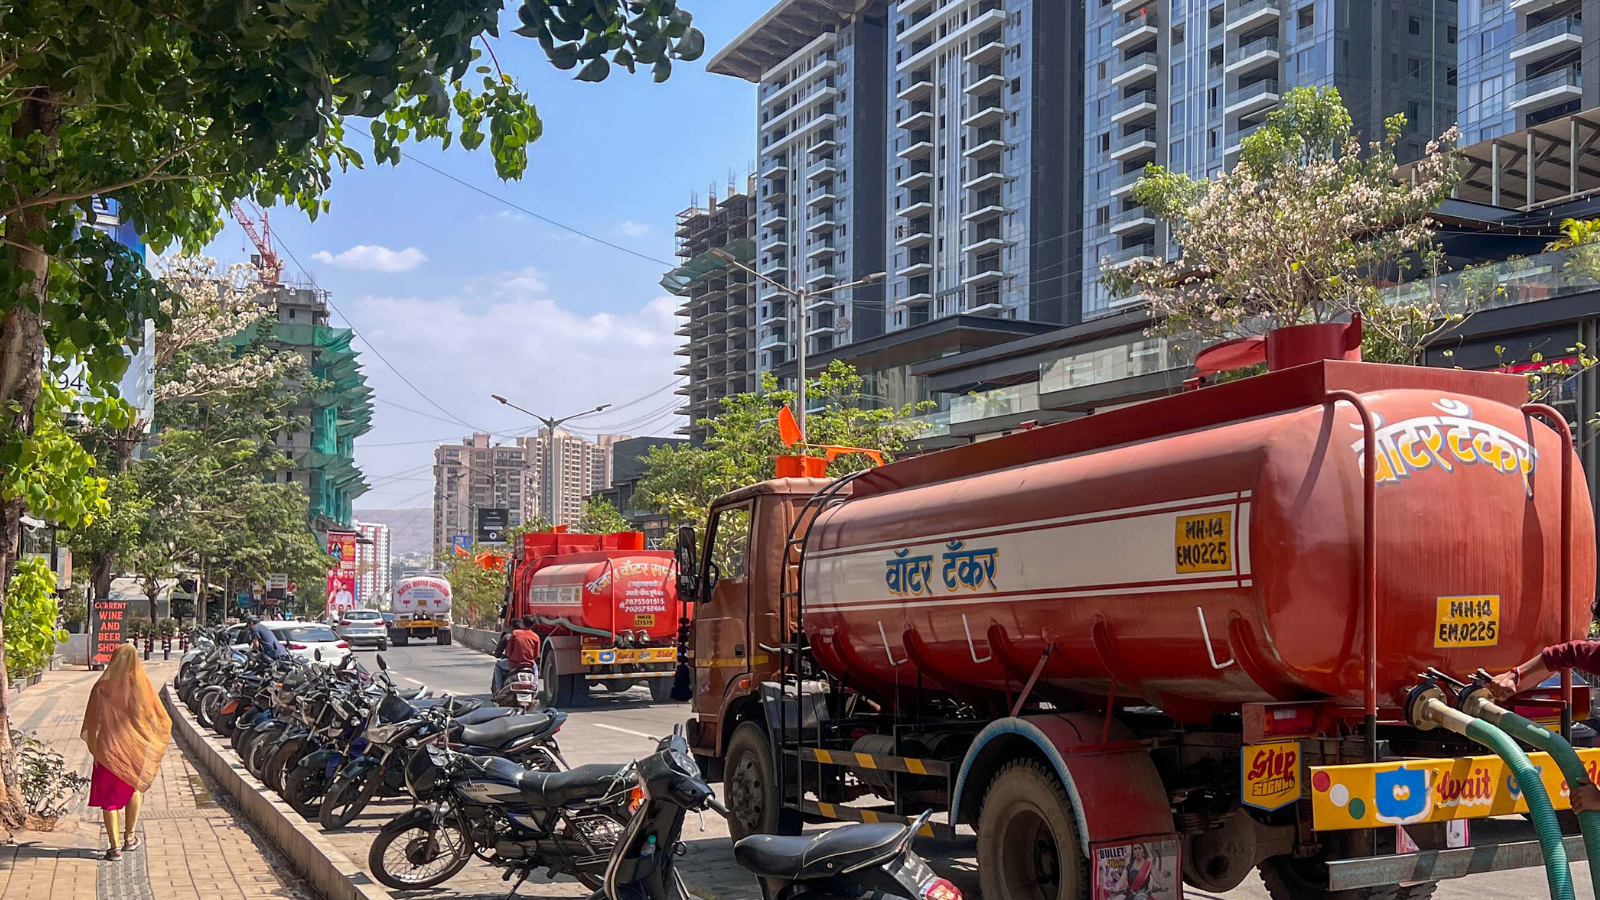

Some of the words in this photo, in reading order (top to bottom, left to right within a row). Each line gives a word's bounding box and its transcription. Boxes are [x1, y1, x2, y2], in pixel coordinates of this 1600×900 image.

[95, 601, 127, 610] CURRENT
[99, 611, 123, 620] WINE
[101, 621, 120, 631] AND
[98, 632, 121, 642] BEER
[1099, 847, 1125, 859] BULLET
